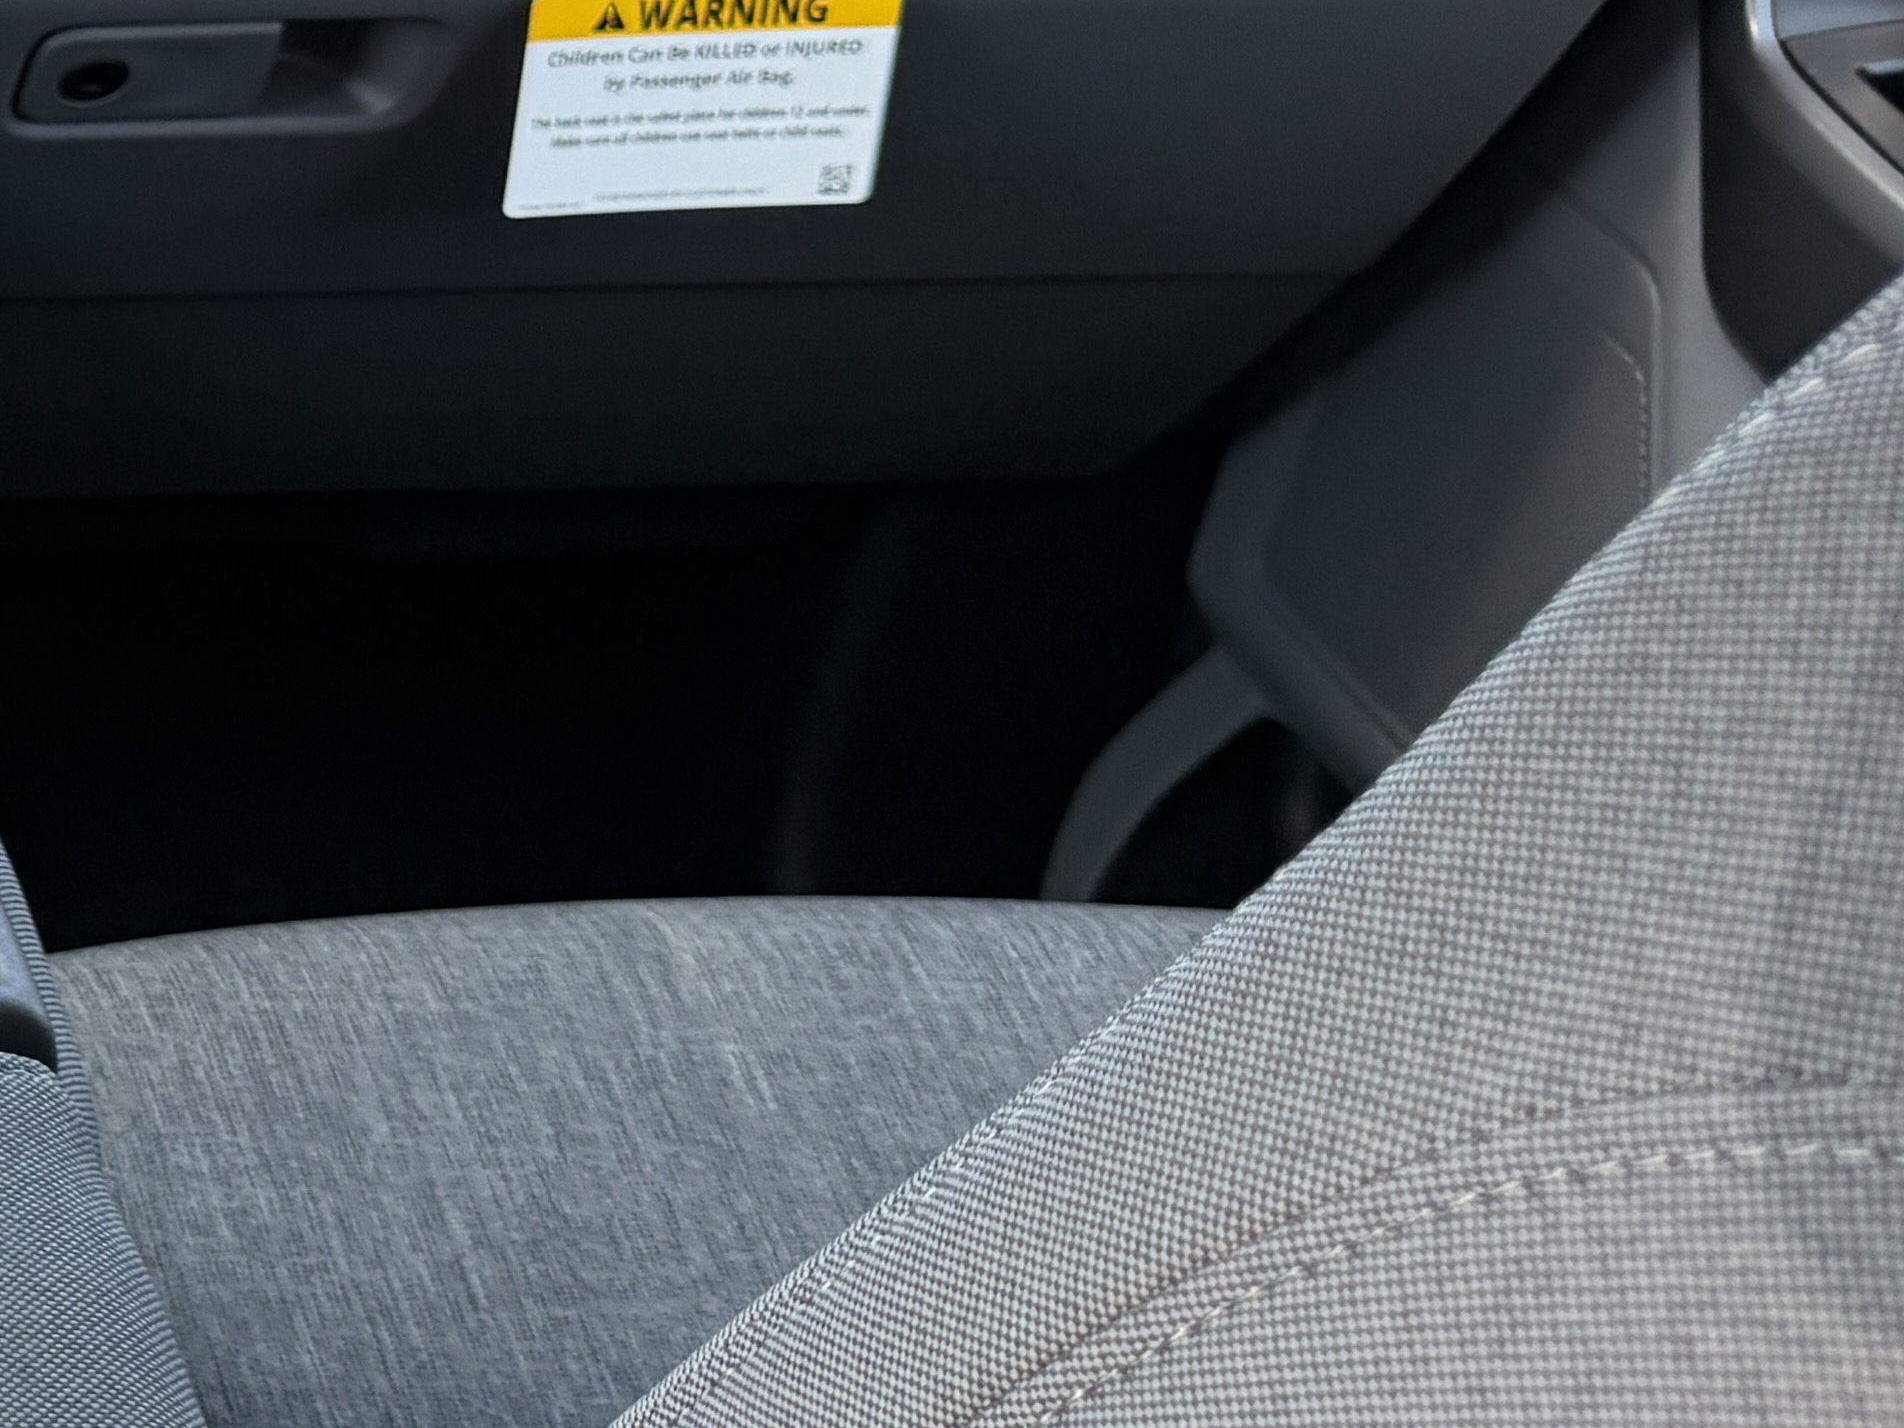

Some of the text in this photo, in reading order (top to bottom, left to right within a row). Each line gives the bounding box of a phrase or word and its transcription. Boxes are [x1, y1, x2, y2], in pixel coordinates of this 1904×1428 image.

[547, 47, 624, 68] Children
[694, 42, 757, 60] KILLED
[785, 39, 864, 60] INJURED
[630, 72, 722, 90] Passenger
